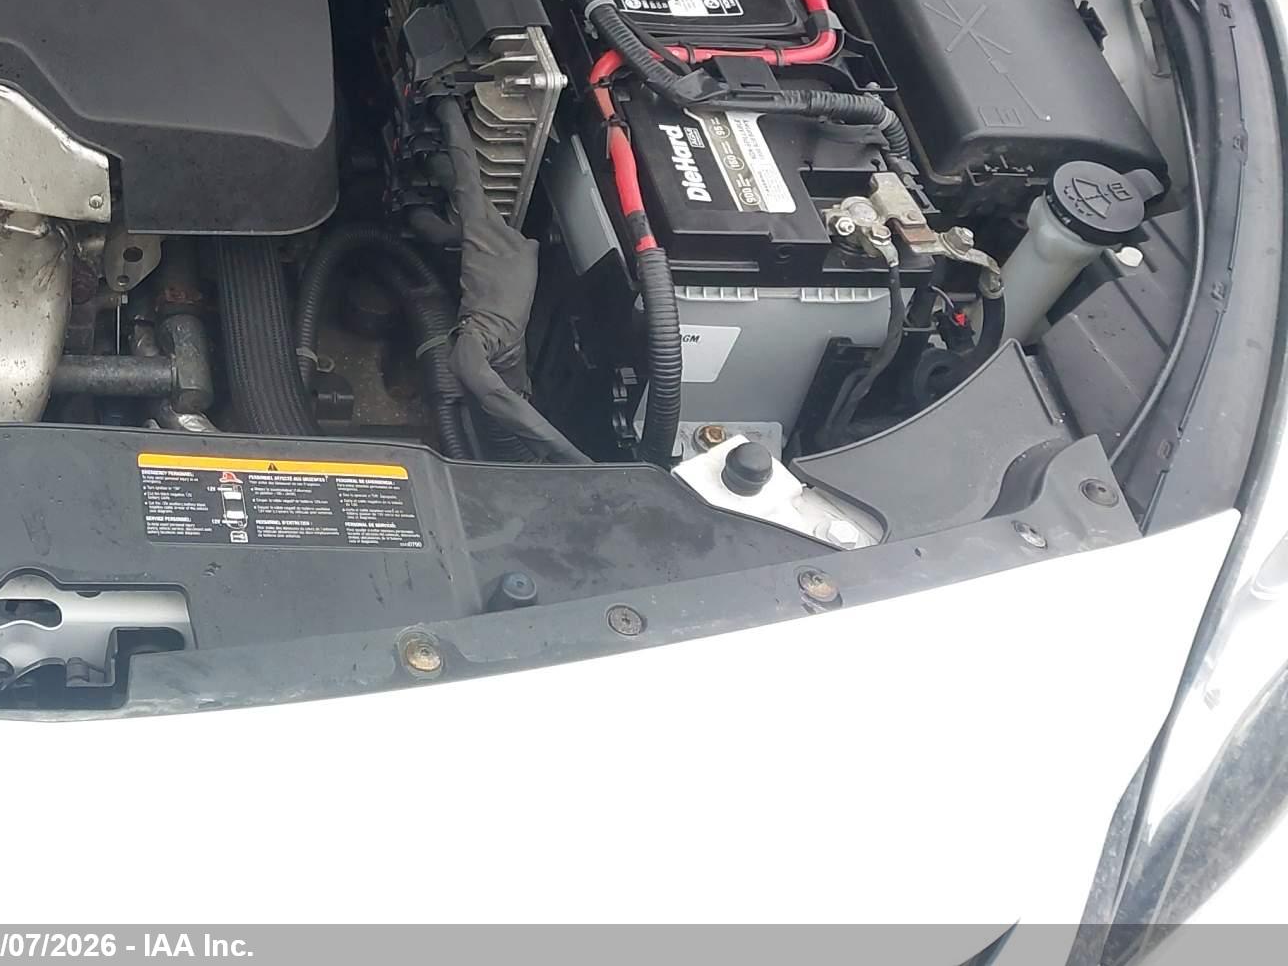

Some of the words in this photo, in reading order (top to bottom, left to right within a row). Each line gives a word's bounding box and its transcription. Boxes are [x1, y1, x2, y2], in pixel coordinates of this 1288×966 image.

[713, 125, 725, 135] 95
[658, 124, 712, 203] DieHard
[742, 187, 757, 204] 900
